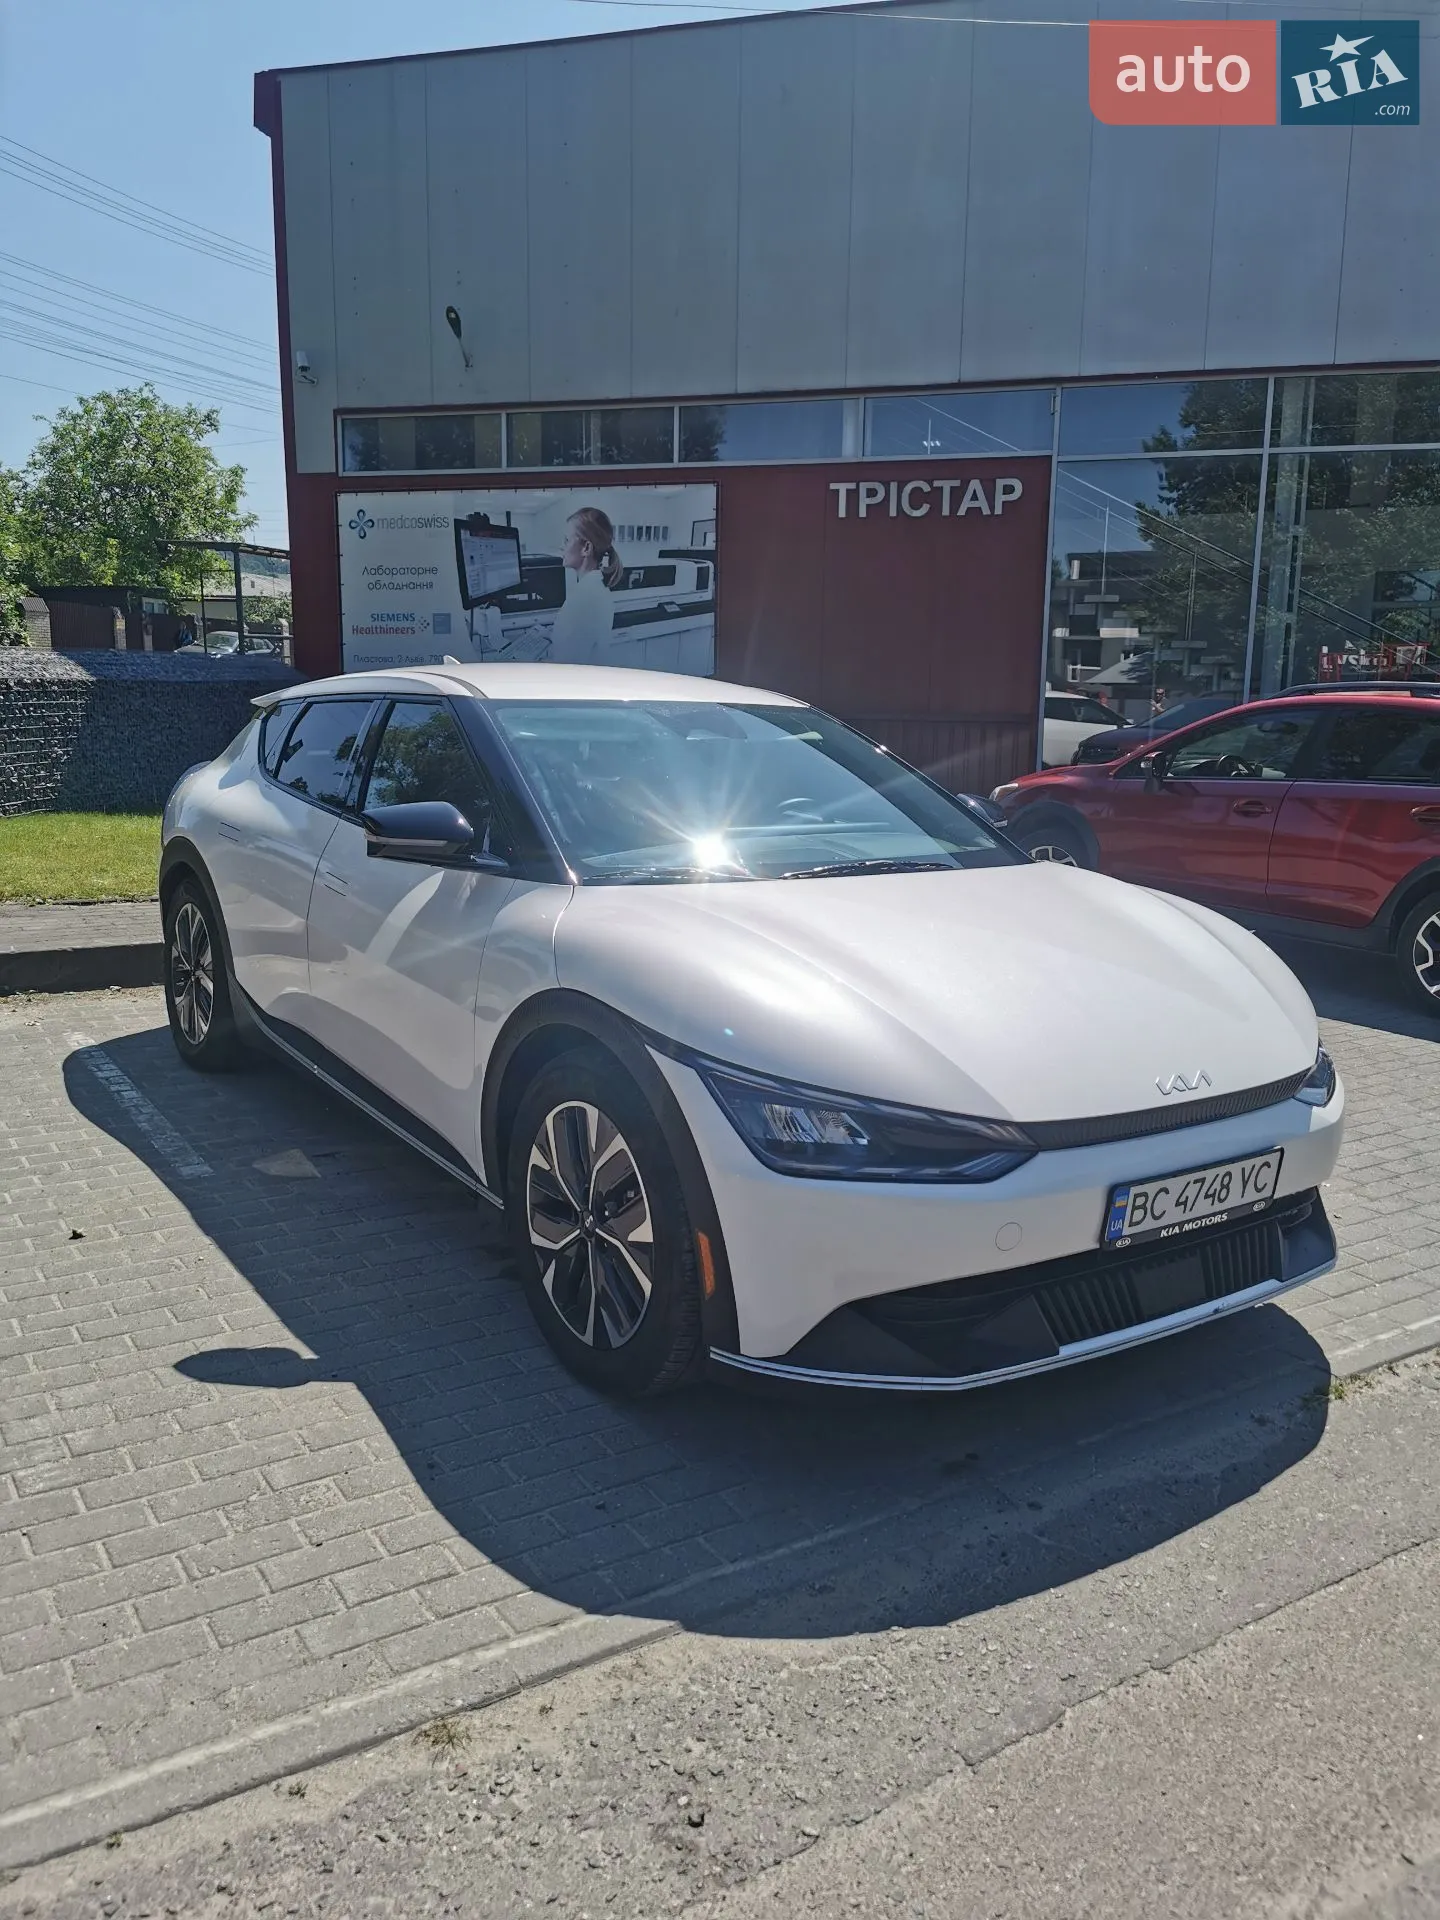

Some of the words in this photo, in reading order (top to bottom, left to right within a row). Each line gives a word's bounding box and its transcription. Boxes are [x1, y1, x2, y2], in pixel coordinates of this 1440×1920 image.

[829, 477, 1024, 518] ТРІСТАР
[376, 513, 450, 530] medcoswiss
[361, 564, 439, 578] Лабораторне
[367, 580, 434, 592] обладнання
[370, 612, 416, 623] SIEMENS
[351, 624, 416, 636] Healthineers
[1127, 1186, 1170, 1228] BC
[1174, 1171, 1233, 1214] 4748
[1240, 1160, 1272, 1199] YC
[1110, 1219, 1123, 1231] UA
[1160, 1225, 1180, 1238] KIA
[1182, 1212, 1229, 1233] MOTORS
[1117, 1238, 1131, 1247] KIA
